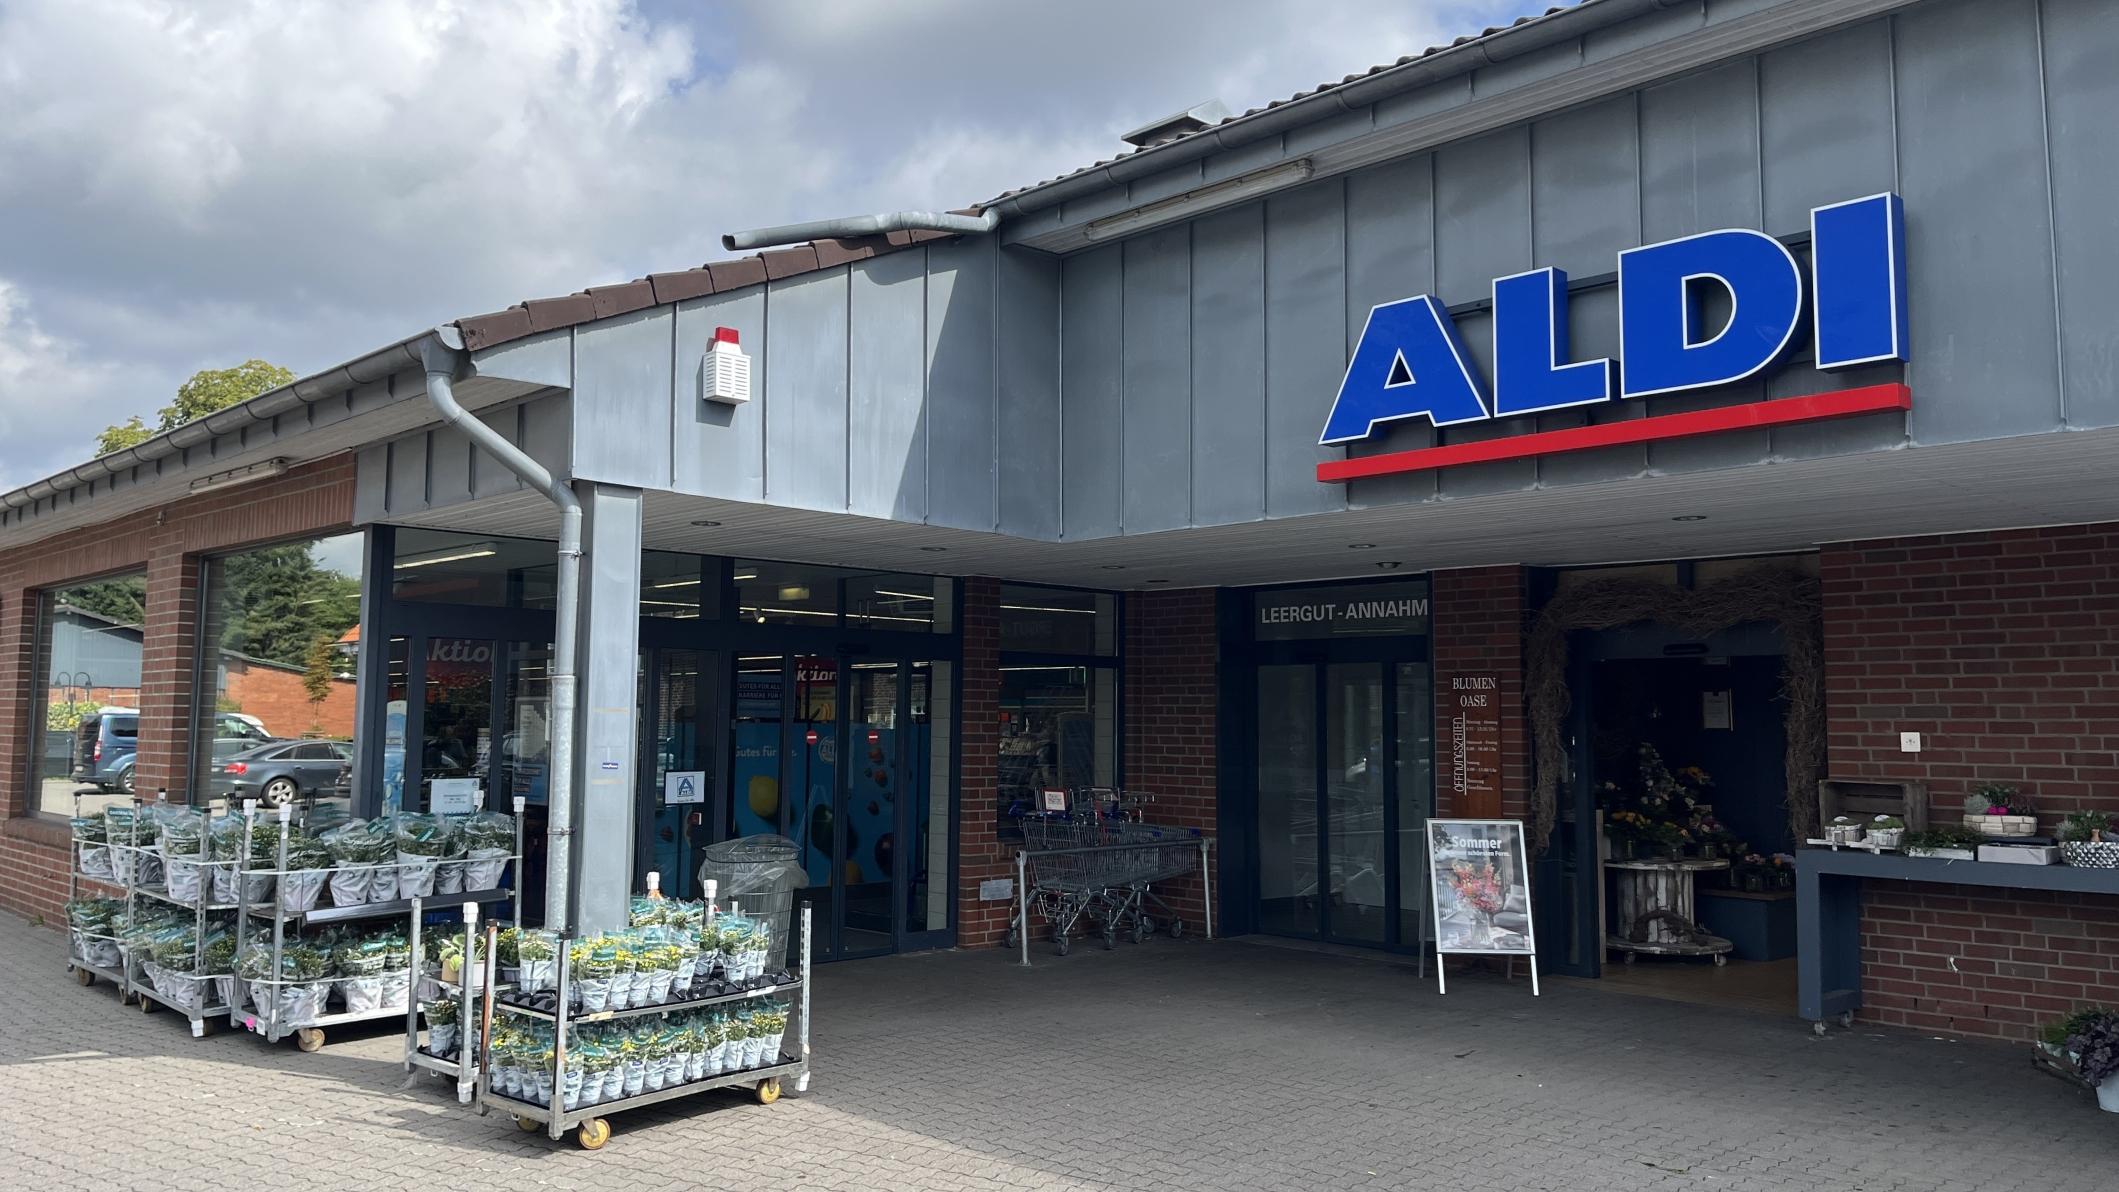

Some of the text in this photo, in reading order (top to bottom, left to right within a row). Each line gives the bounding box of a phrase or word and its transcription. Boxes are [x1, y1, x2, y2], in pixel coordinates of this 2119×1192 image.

[1318, 191, 1909, 444] ALDI
[1452, 677, 1497, 690] BLUMEN
[1460, 694, 1488, 707] OASE
[1452, 836, 1503, 849] Sommer
